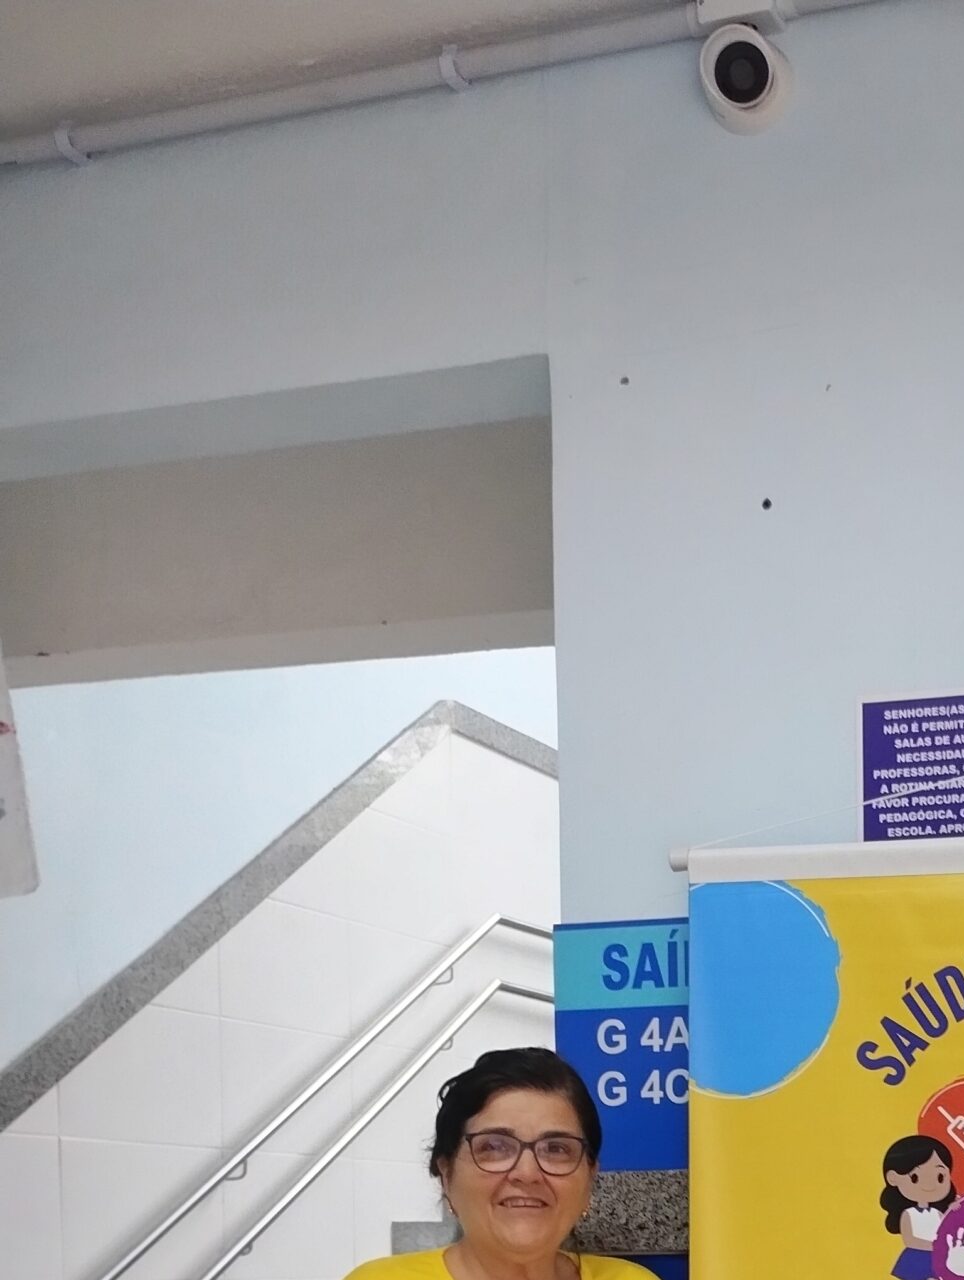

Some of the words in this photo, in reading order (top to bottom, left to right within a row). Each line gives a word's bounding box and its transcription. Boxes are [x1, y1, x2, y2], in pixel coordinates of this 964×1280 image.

[883, 722, 909, 735] NÃO
[911, 721, 919, 733] É
[894, 737, 932, 749] SALAS
[934, 735, 951, 746] DE
[873, 764, 960, 780] PROFESSORAS,
[880, 783, 889, 794] A
[891, 780, 935, 793] ROTINA
[878, 809, 957, 823] PEDAGÓGICA,
[887, 825, 936, 837] ESCOLA.
[602, 929, 689, 991] SAÍ
[597, 1018, 627, 1055] G
[640, 1016, 689, 1053] 4A
[597, 1071, 627, 1107] G
[640, 1068, 689, 1105] 4C
